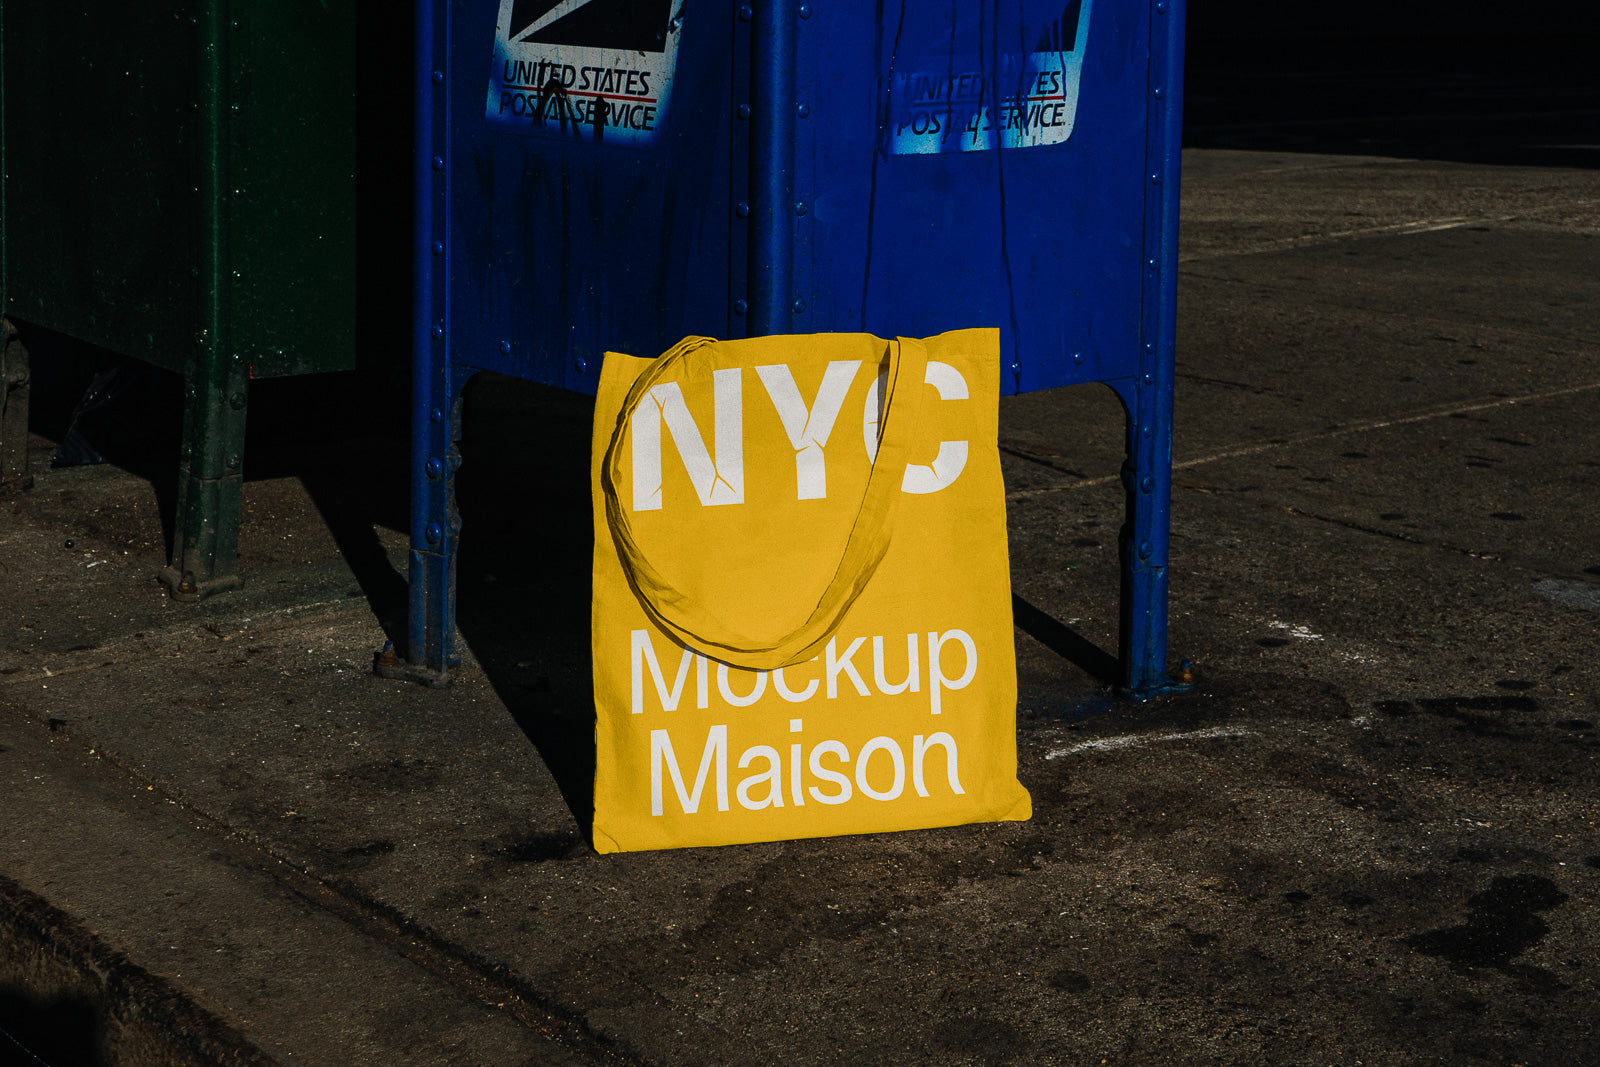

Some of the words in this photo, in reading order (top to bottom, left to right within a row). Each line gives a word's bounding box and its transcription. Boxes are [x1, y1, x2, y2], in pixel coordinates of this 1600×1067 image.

[503, 59, 577, 88] UNITED
[579, 65, 652, 96] STATES
[631, 360, 969, 511] NYC
[630, 629, 977, 715] Mockup
[650, 718, 966, 816] Maison
